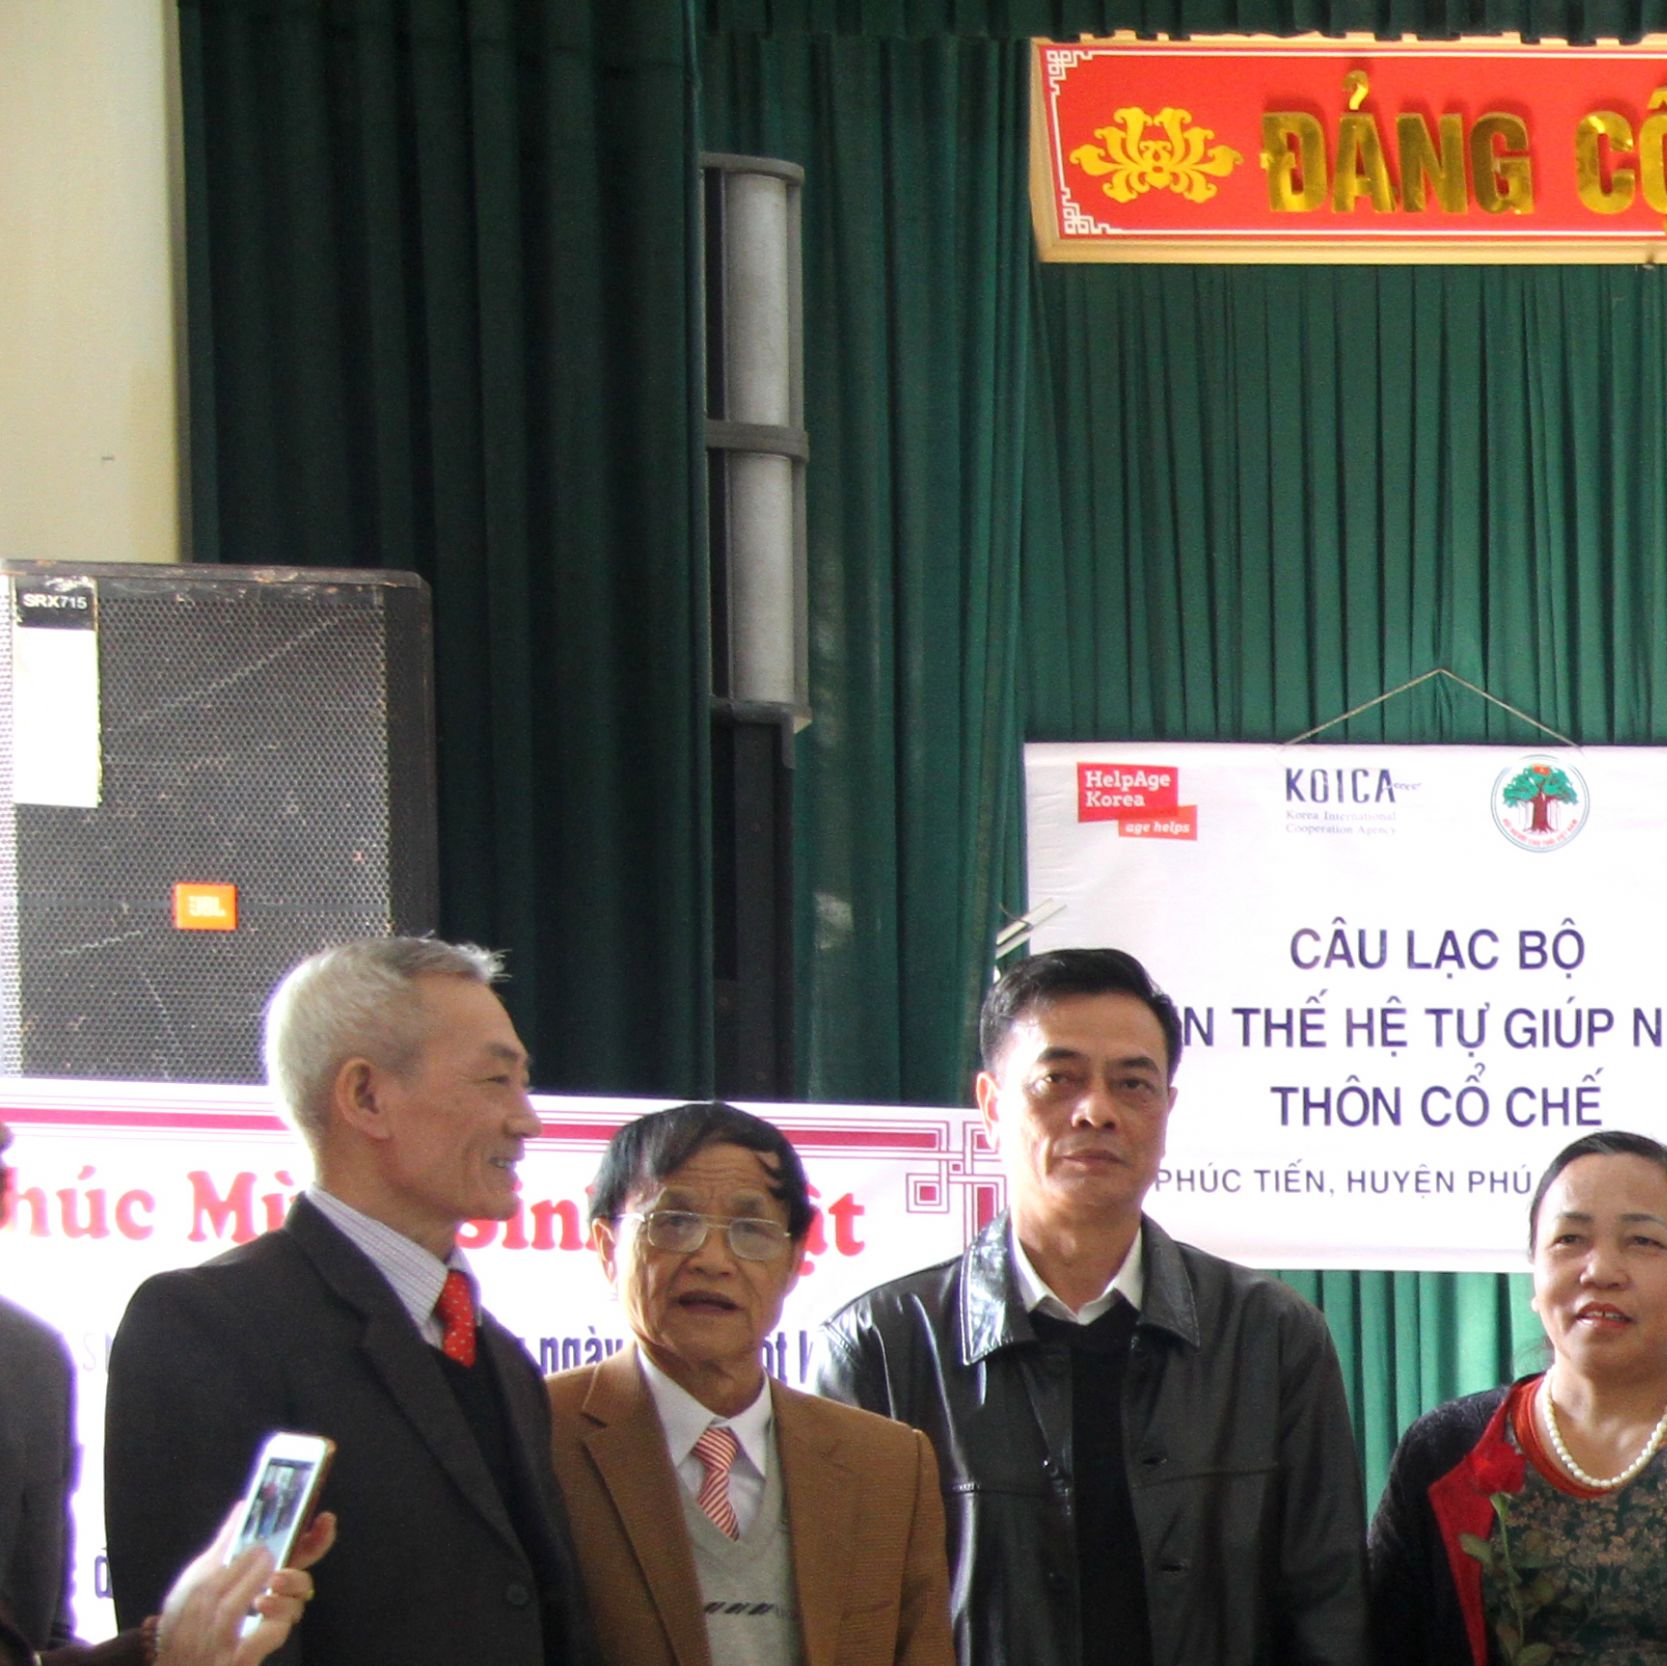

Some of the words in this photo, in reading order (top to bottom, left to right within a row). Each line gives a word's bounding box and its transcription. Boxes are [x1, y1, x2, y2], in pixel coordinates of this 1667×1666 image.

[1260, 70, 1535, 215] ĐẢNG
[23, 593, 88, 610] SRX715
[1085, 770, 1172, 792] HelpAge
[1085, 790, 1146, 808] Korea
[1286, 768, 1396, 803] KOICA
[1125, 823, 1151, 836] age
[1153, 820, 1191, 835] helps
[1289, 917, 1389, 970] CÂU
[1406, 928, 1500, 979] LẠC
[1518, 917, 1586, 979] BỘ
[1231, 988, 1328, 1047] THẾ
[1345, 995, 1407, 1056] HỆ
[1424, 1002, 1491, 1058] TỰ
[1503, 997, 1615, 1050] GIÚP
[1270, 1074, 1402, 1127] THÔN
[1418, 1062, 1490, 1127] CỔ
[1505, 1067, 1604, 1127] CHẾ
[1155, 1160, 1242, 1194] PHÚC
[1253, 1158, 1335, 1197] TIẾN,
[1346, 1163, 1455, 1200] HUYỆN
[1467, 1162, 1533, 1195] PHÚ
[3, 1165, 156, 1241] húc
